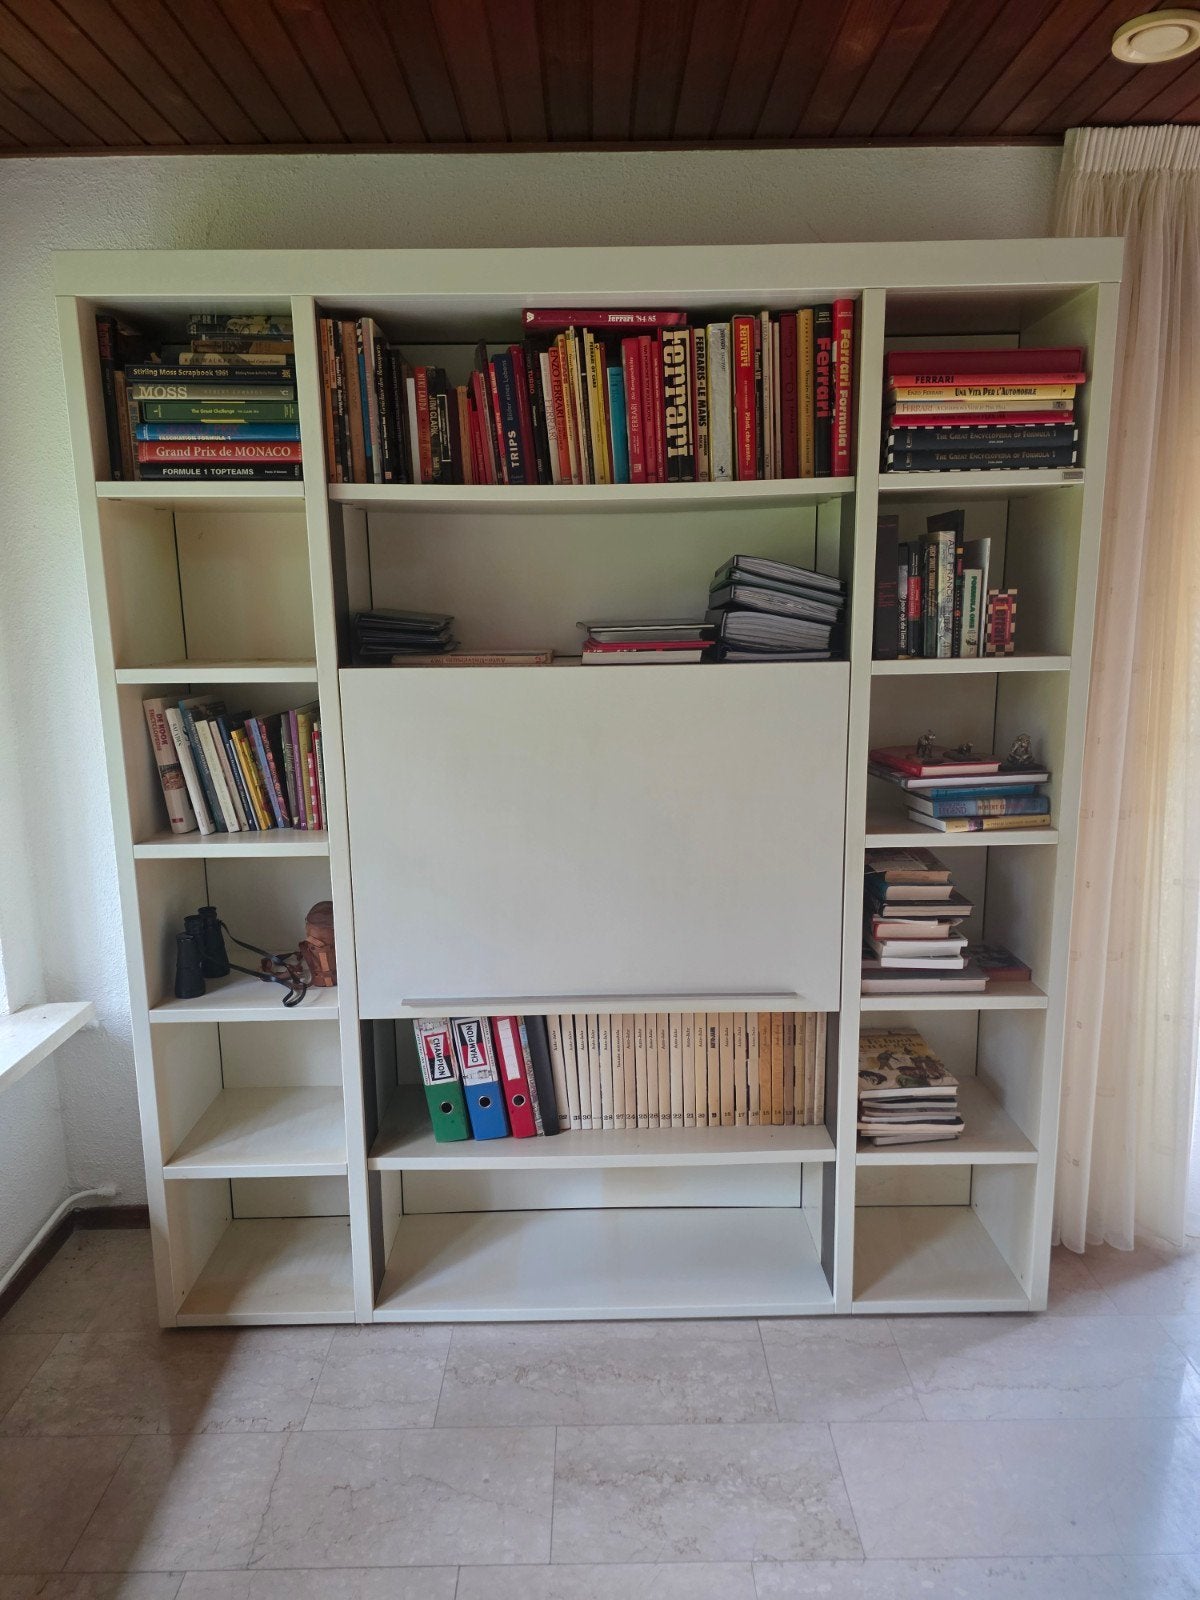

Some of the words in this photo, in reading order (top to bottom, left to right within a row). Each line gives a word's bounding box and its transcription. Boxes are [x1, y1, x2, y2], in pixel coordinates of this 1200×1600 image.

[608, 314, 634, 322] Ferrari
[696, 336, 705, 381] FERRARIS
[739, 324, 750, 367] Ferrari
[840, 328, 851, 386] Ferrari
[133, 368, 158, 377] Stirling
[178, 369, 214, 378] Scrapbook
[550, 350, 561, 378] ENZO
[817, 337, 831, 418] Ferrari
[138, 386, 188, 399] MOSS
[697, 387, 706, 397] LE
[915, 375, 954, 384] FERRARI
[419, 390, 427, 411] LAUDA
[428, 395, 437, 411] JIM
[553, 380, 564, 418] FERRARI
[662, 330, 693, 458] Ferrari
[430, 412, 438, 437] CLARK
[545, 399, 557, 440] FERRARI
[698, 400, 706, 426] MANS
[838, 389, 849, 447] Formula
[507, 430, 520, 468] TRIPS
[969, 432, 1013, 440] ENCYCLOPEDIA
[156, 446, 192, 457] Grand
[194, 447, 217, 457] Prix
[219, 447, 232, 457] de
[235, 446, 291, 457] MONACO
[969, 576, 977, 613] FORMULA
[149, 709, 162, 751] ENCYCLOPEDIE
[155, 713, 163, 724] DE
[157, 724, 169, 746] KOOK
[433, 1038, 446, 1076] CHAMPION
[466, 1025, 479, 1063] CHAMPION
